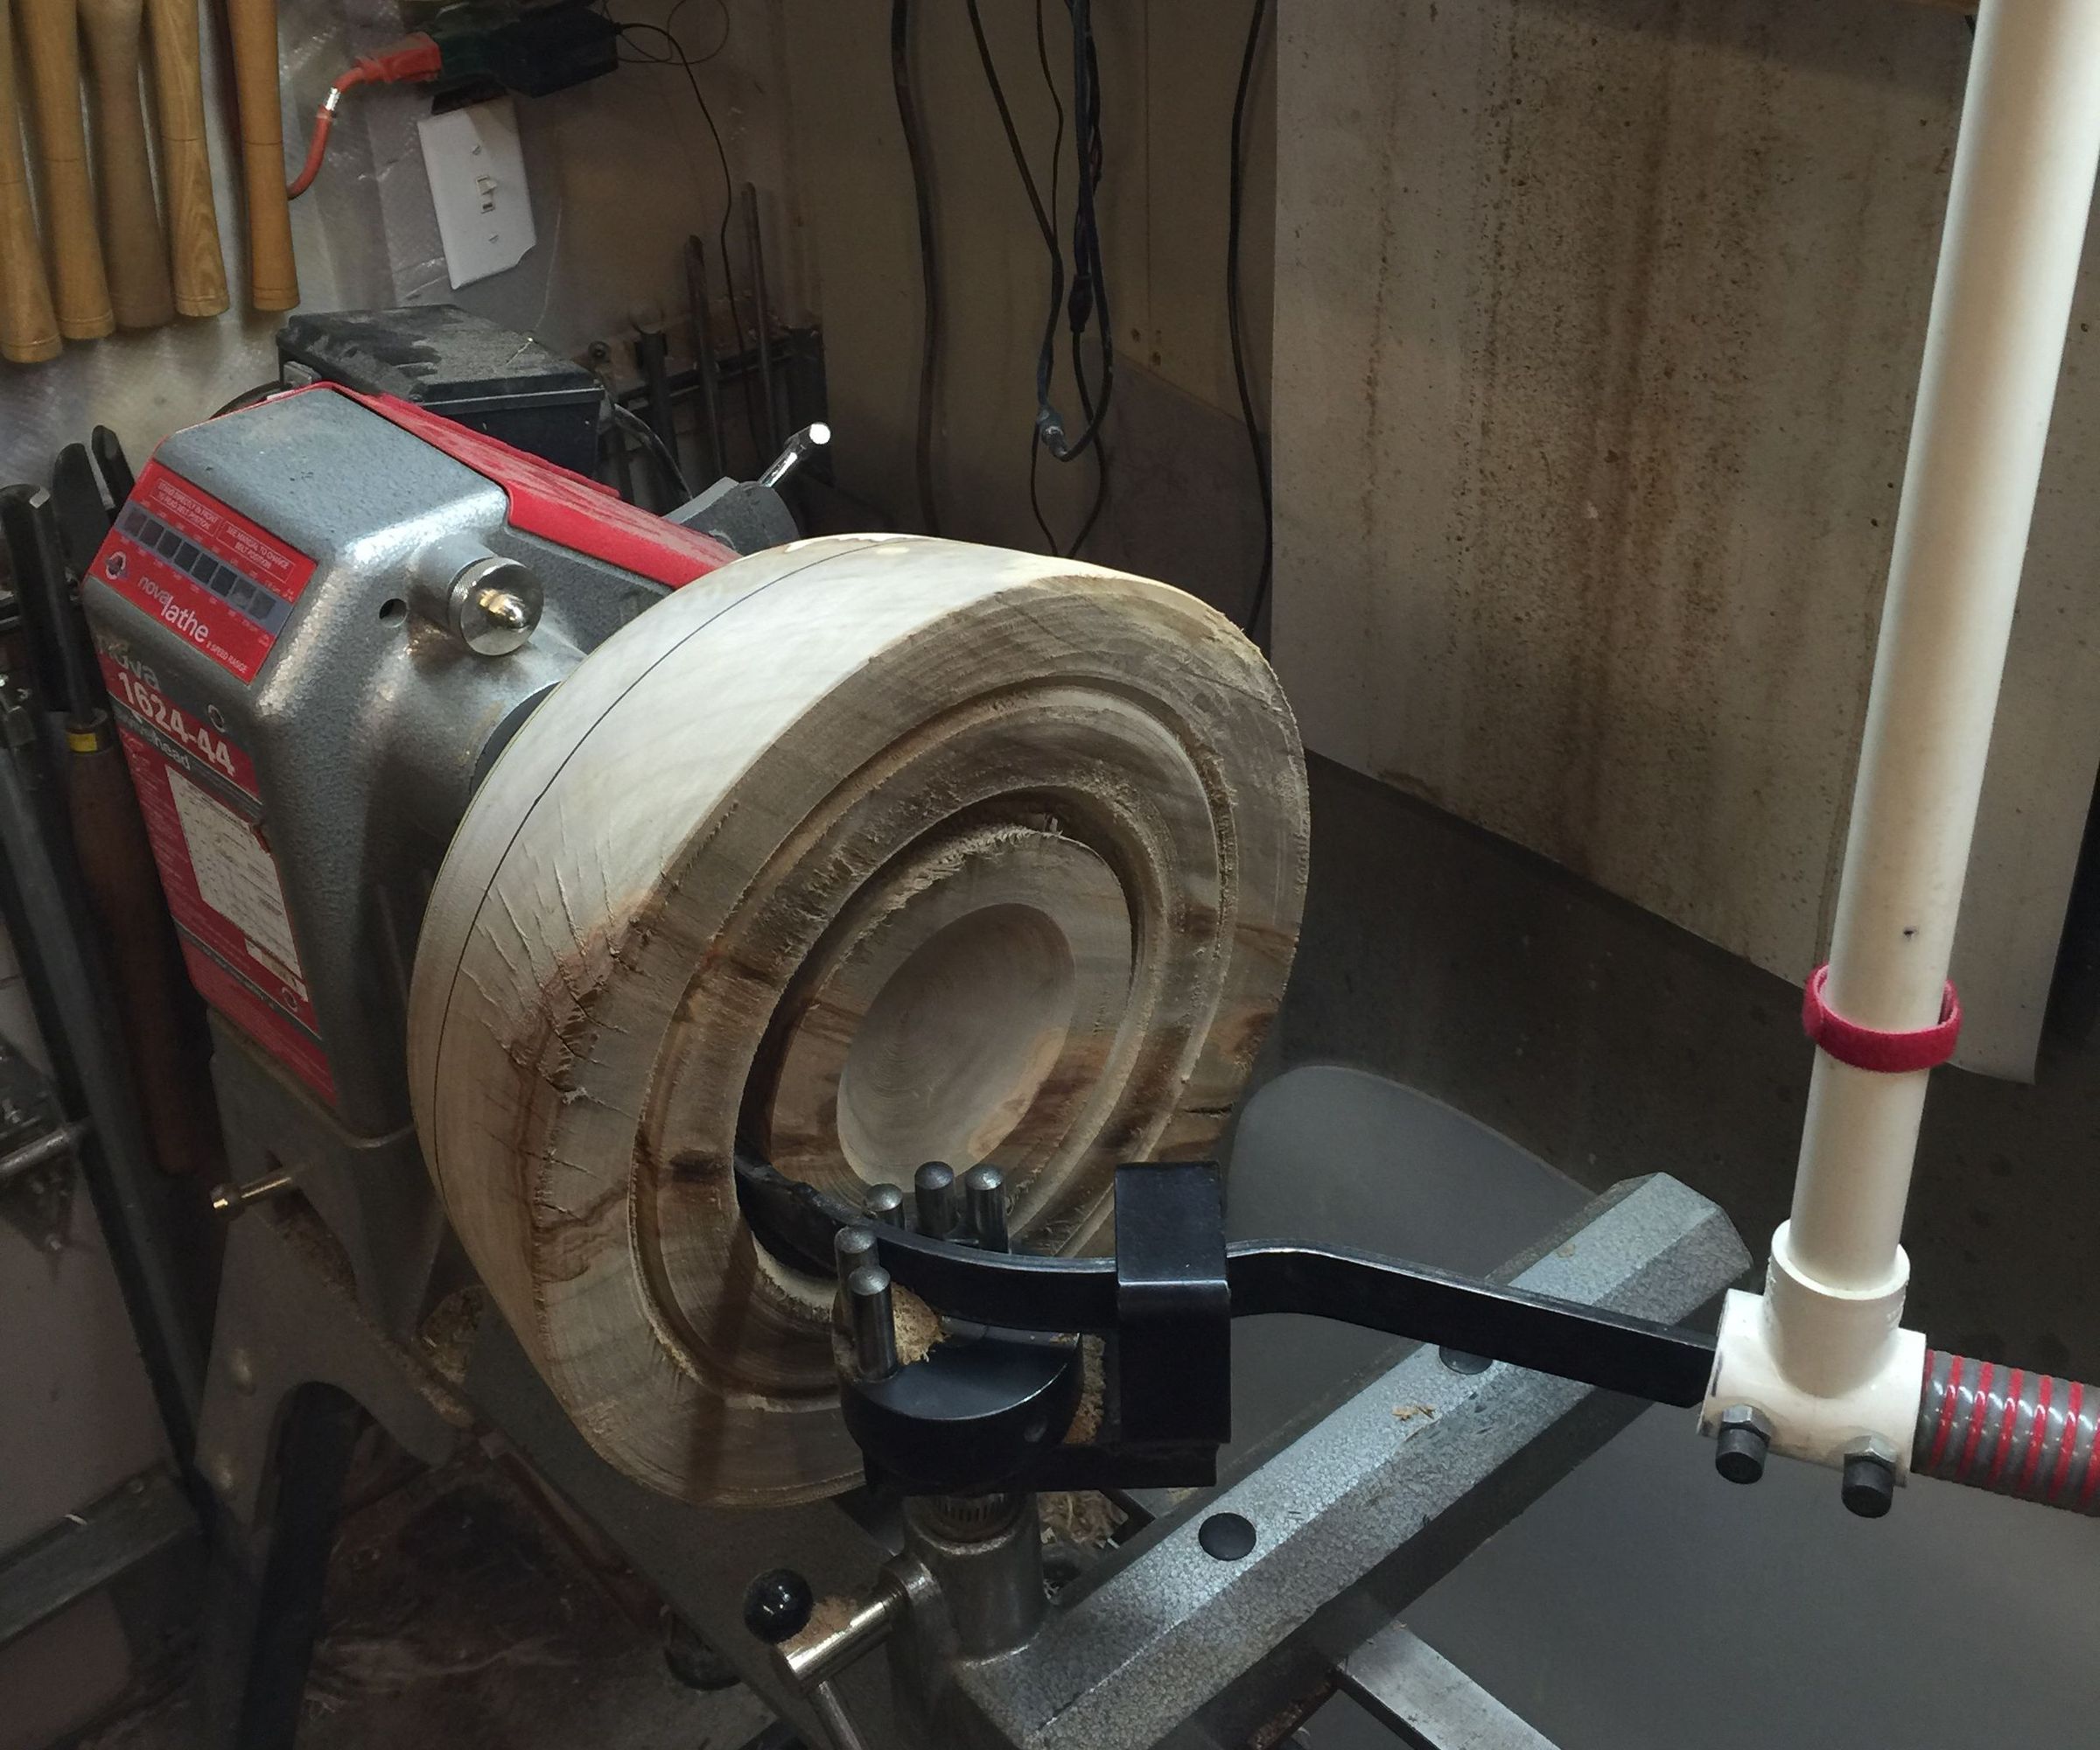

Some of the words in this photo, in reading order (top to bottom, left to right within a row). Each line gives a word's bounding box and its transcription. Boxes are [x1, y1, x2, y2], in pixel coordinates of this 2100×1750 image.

[234, 542, 248, 553] BELT
[247, 550, 270, 569] POSITION
[259, 546, 267, 555] TO
[266, 551, 288, 569] CHANGE
[209, 643, 228, 659] SPEED
[228, 654, 248, 672] RANGE
[118, 671, 236, 777] 1624-44
